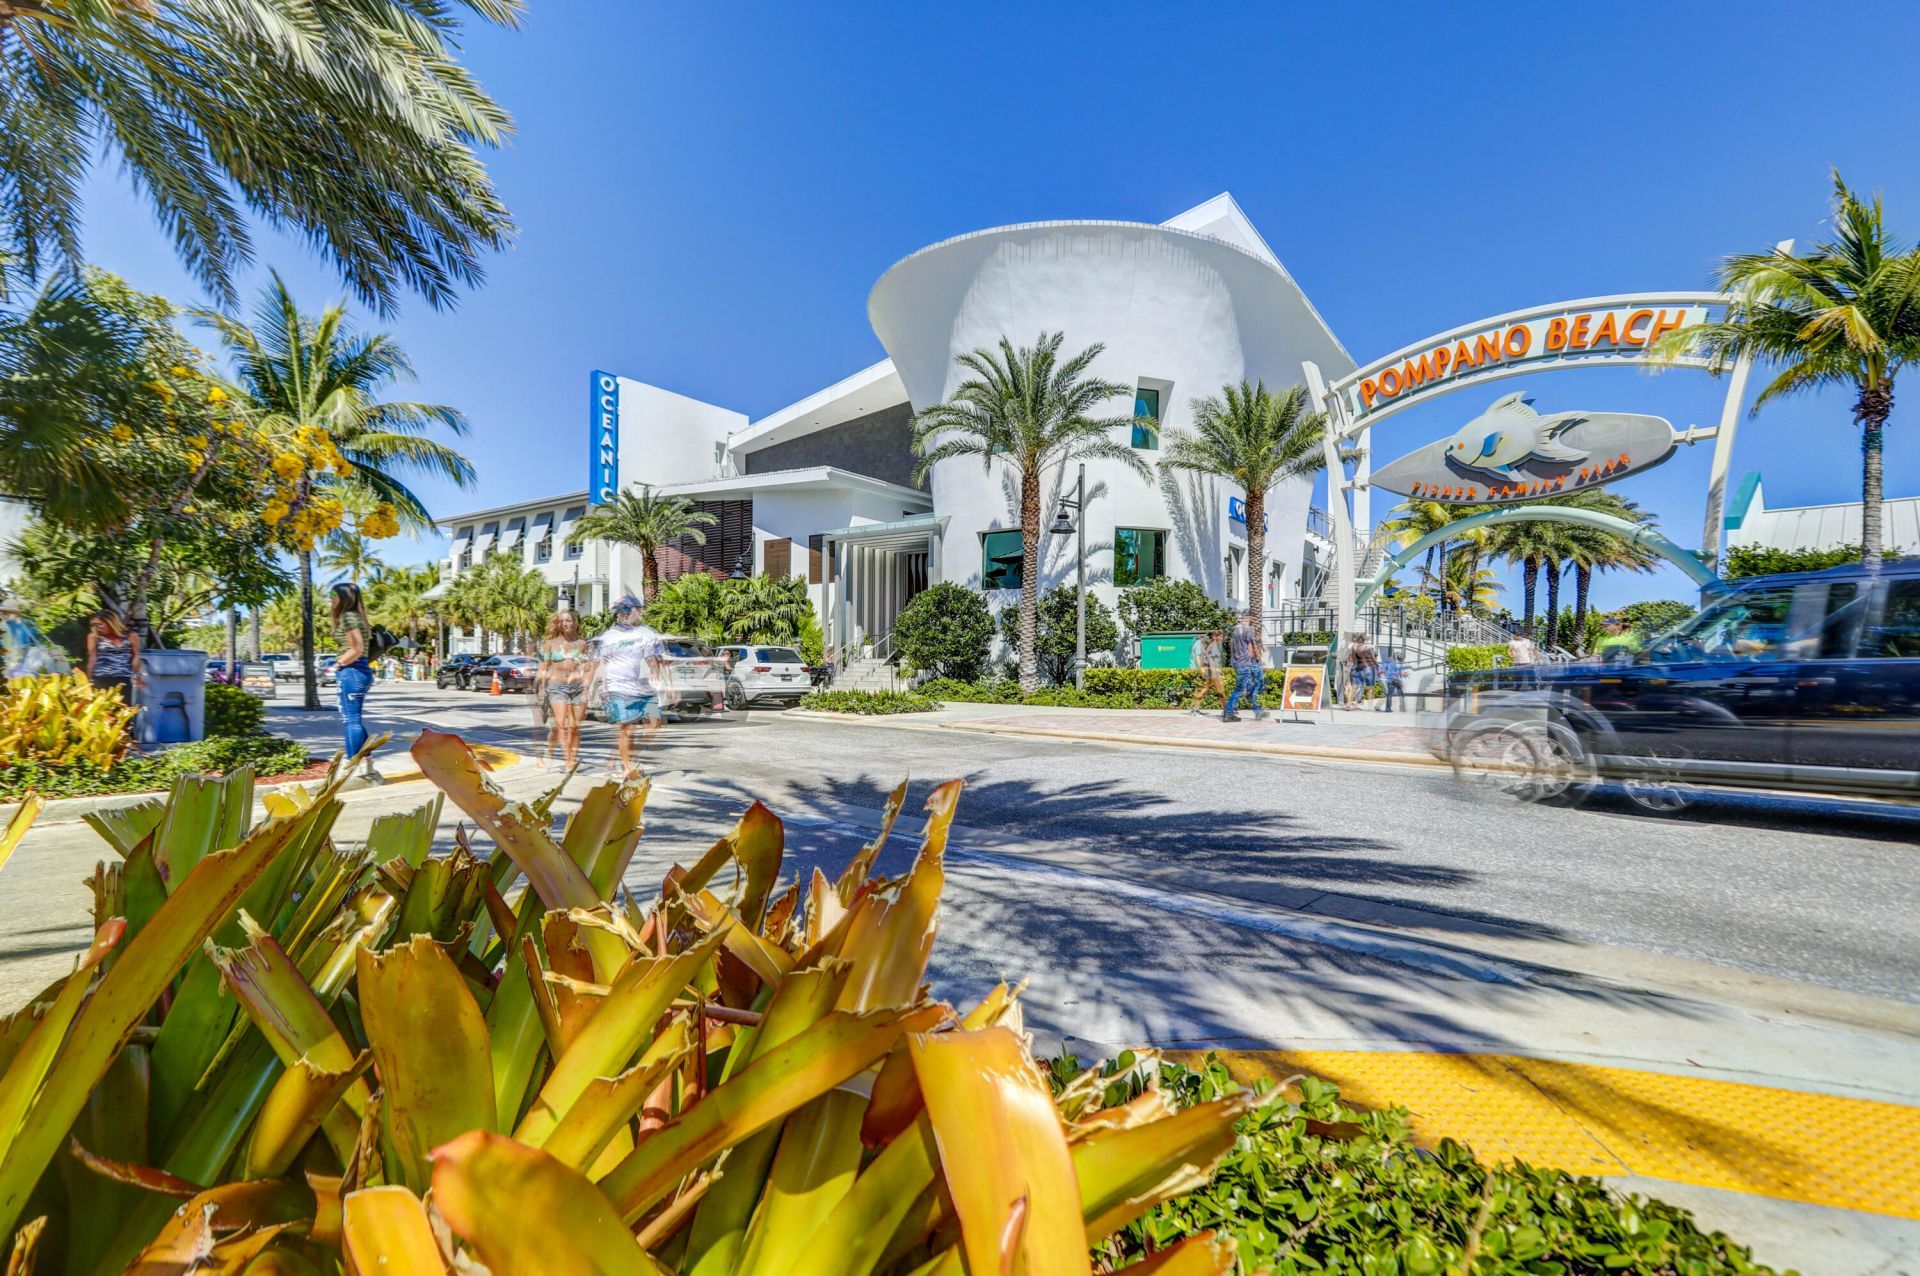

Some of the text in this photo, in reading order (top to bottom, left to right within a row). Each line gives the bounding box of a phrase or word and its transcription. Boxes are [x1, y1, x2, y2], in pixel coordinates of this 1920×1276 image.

[1359, 309, 1687, 408] POMPANO BEACH
[600, 376, 615, 503] OCEANIC
[1489, 473, 1566, 497] FAMILY
